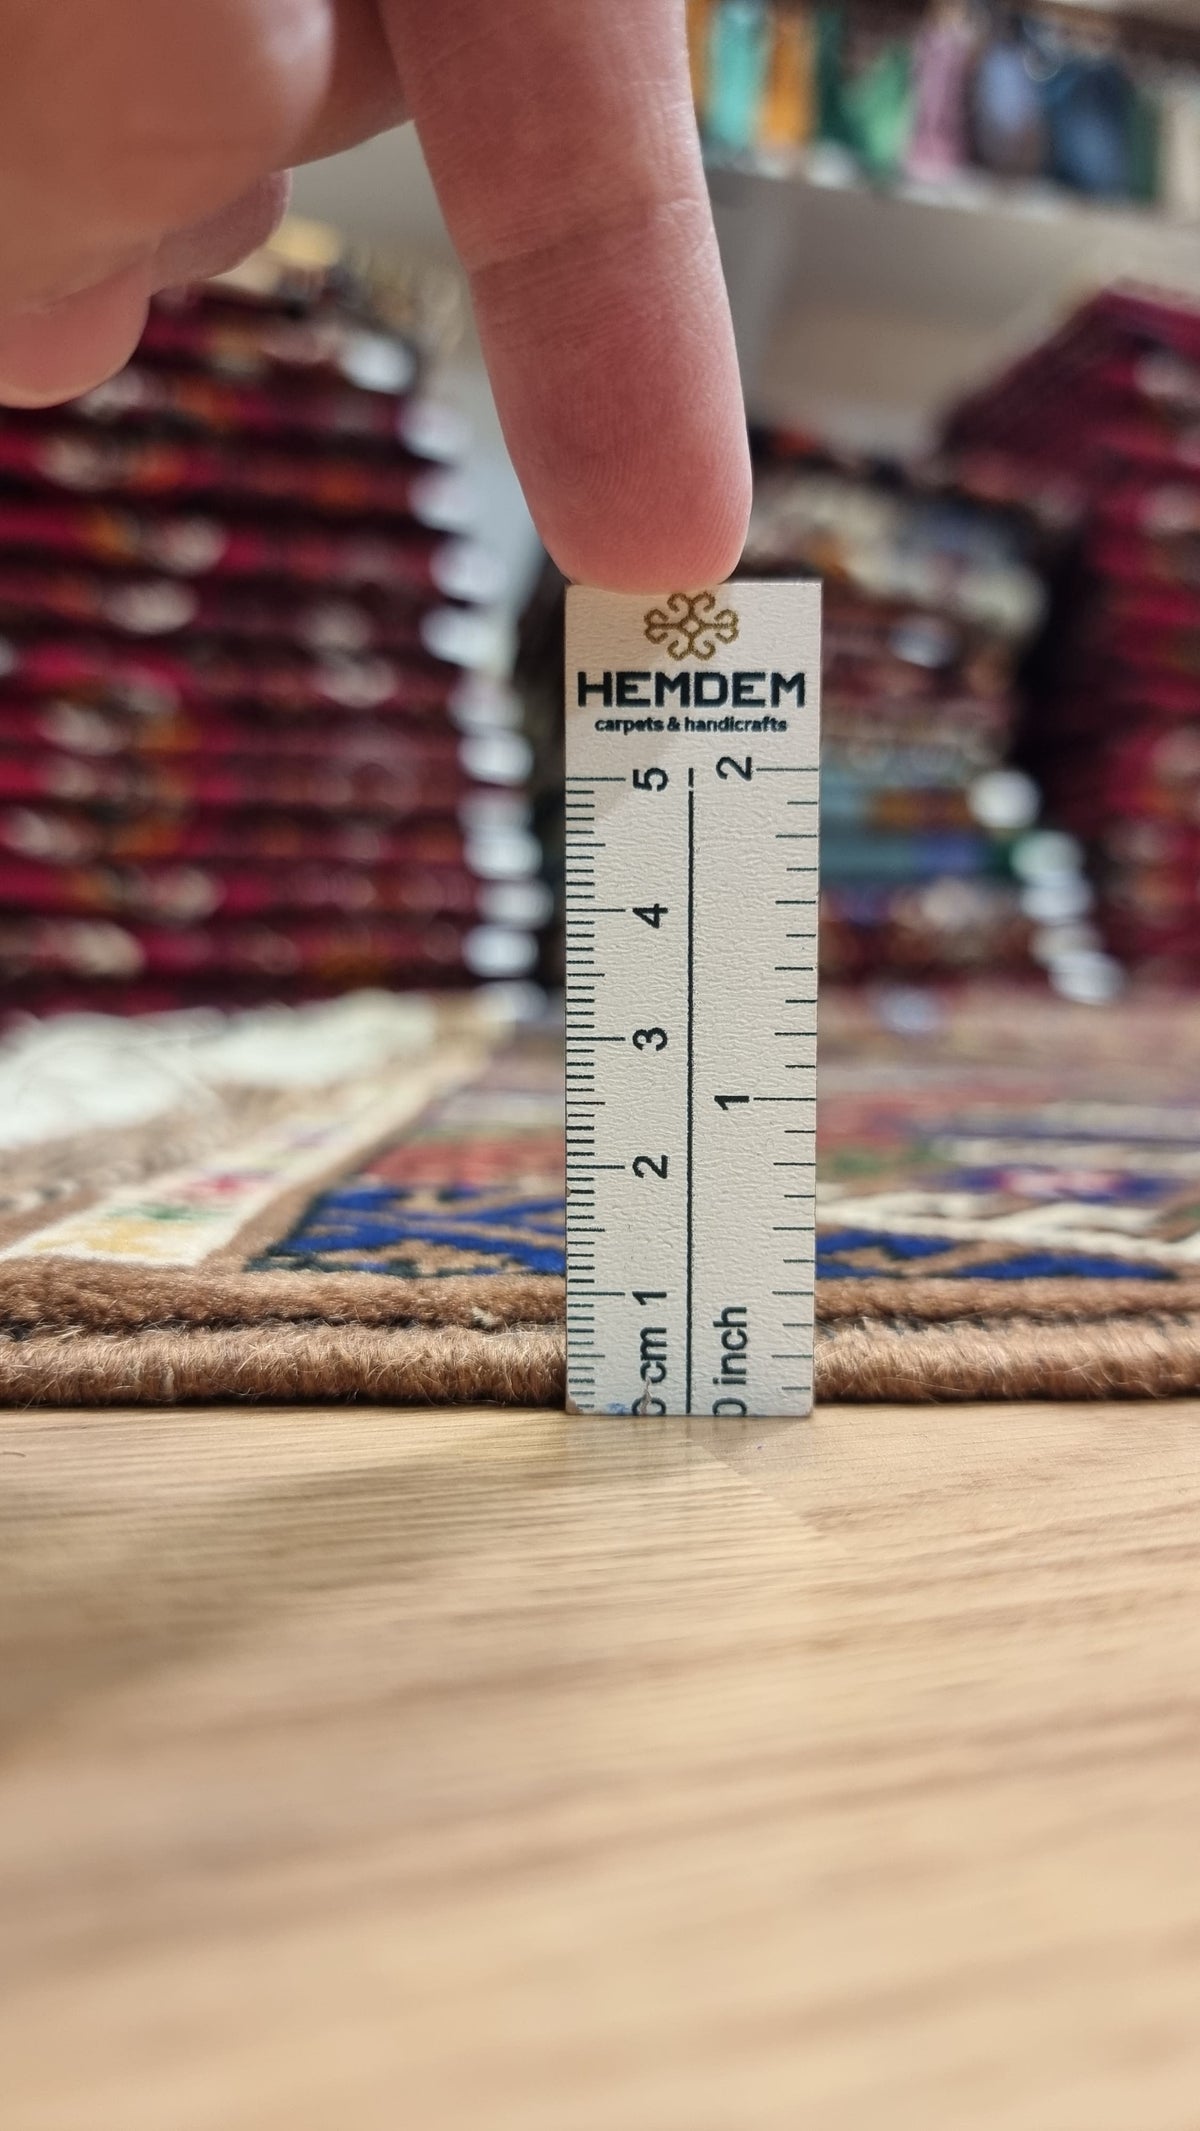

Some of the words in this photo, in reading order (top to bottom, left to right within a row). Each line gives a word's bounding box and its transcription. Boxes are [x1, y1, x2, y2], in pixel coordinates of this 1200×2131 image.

[577, 671, 806, 708] HEMDEM
[594, 716, 665, 736] carpets
[666, 715, 681, 733] &
[684, 715, 788, 733] handicrafts
[632, 766, 670, 792] 5
[715, 756, 752, 782] 2
[631, 902, 669, 930] 4
[631, 1026, 669, 1052] 3
[713, 1094, 750, 1111] 1
[631, 1154, 669, 1180] 2
[631, 1290, 668, 1306] 1
[639, 1326, 668, 1384] cm
[712, 1306, 749, 1386] inch
